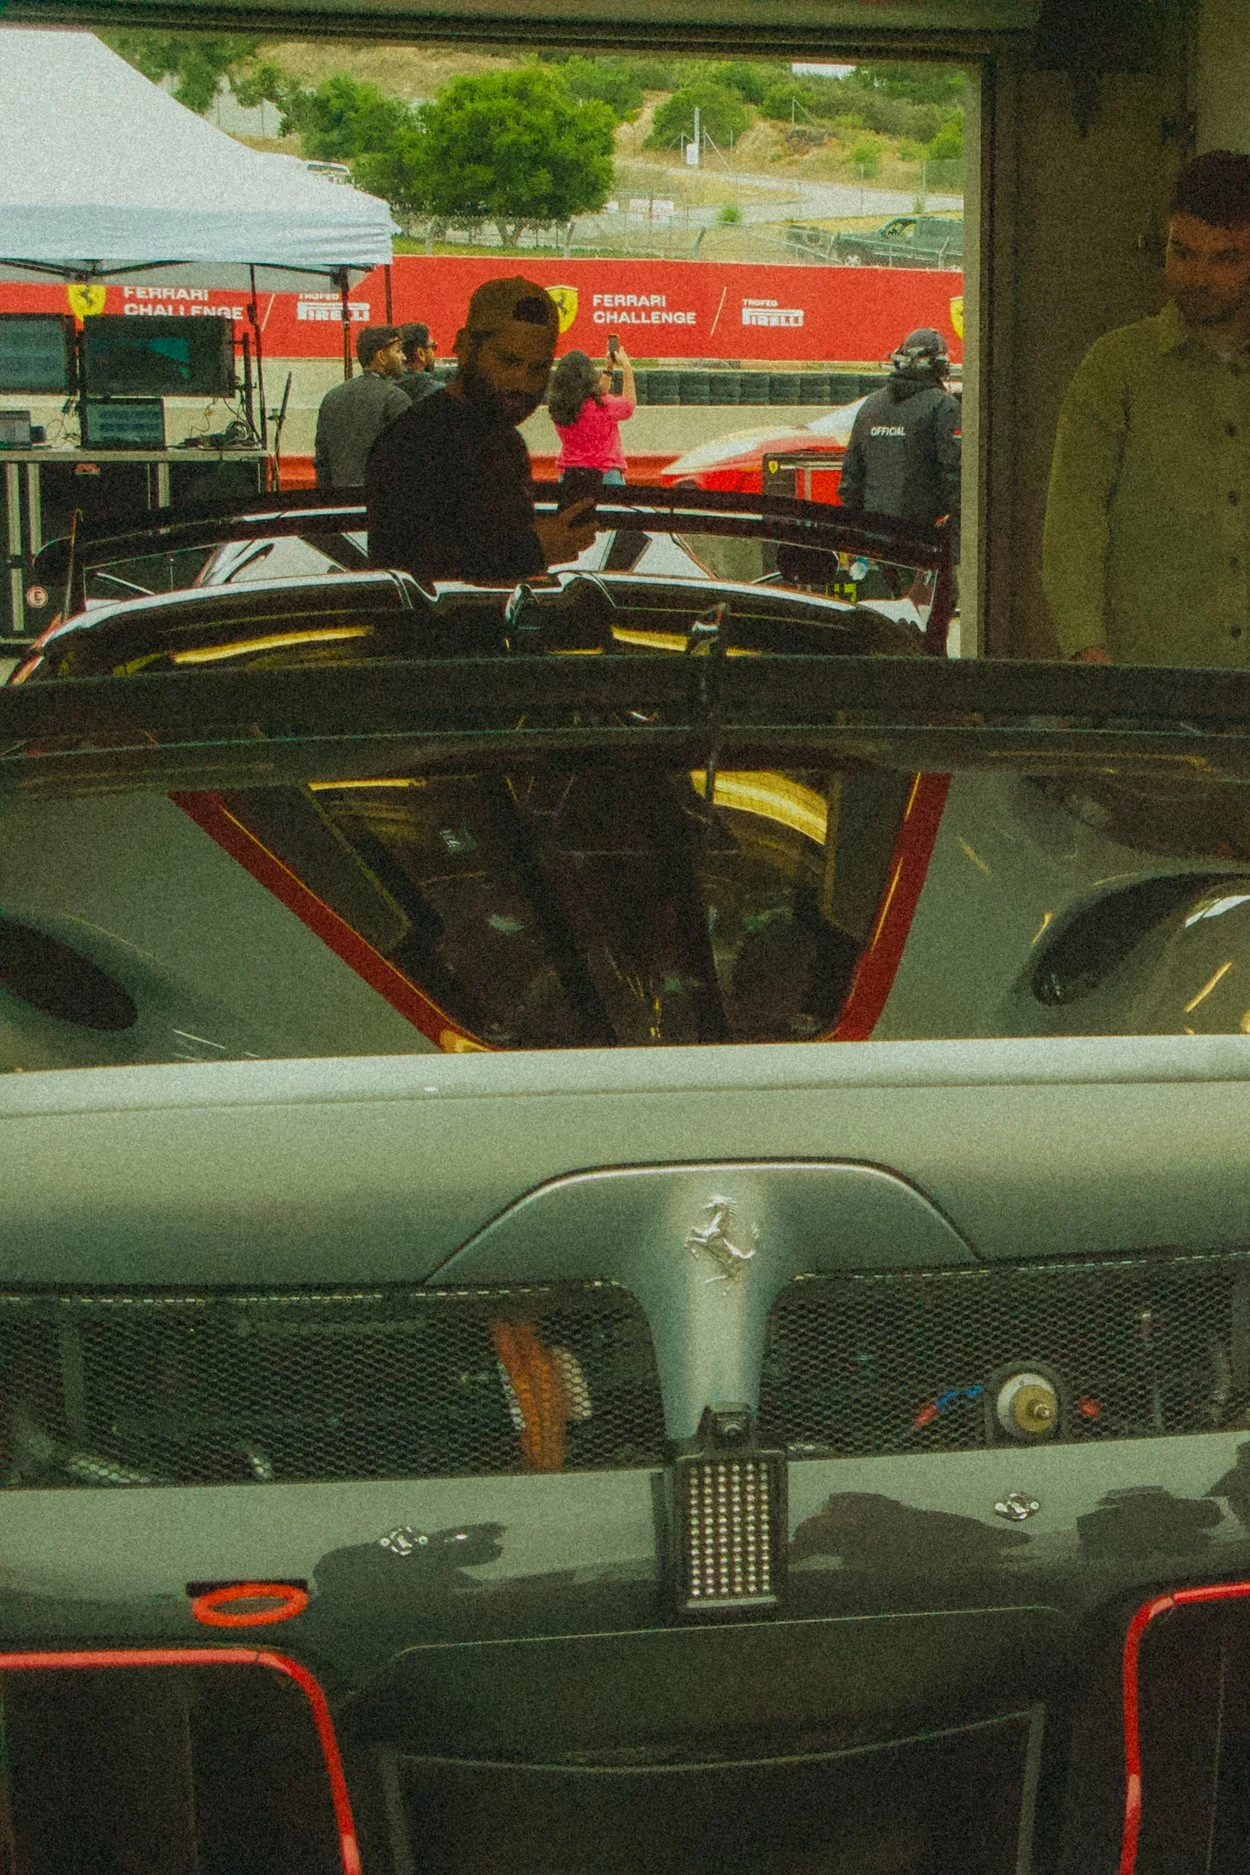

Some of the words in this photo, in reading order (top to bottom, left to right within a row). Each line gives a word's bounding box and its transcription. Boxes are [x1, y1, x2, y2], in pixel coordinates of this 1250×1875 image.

[123, 286, 209, 301] FERRARI
[592, 294, 667, 307] FERRARI
[742, 299, 778, 307] TROFEO
[123, 303, 244, 320] CHALLENGE
[297, 301, 371, 322] PIRELI
[592, 310, 697, 325] CHALLENGE
[742, 307, 805, 327] PIRELLI
[871, 426, 905, 436] OFFICIAL
